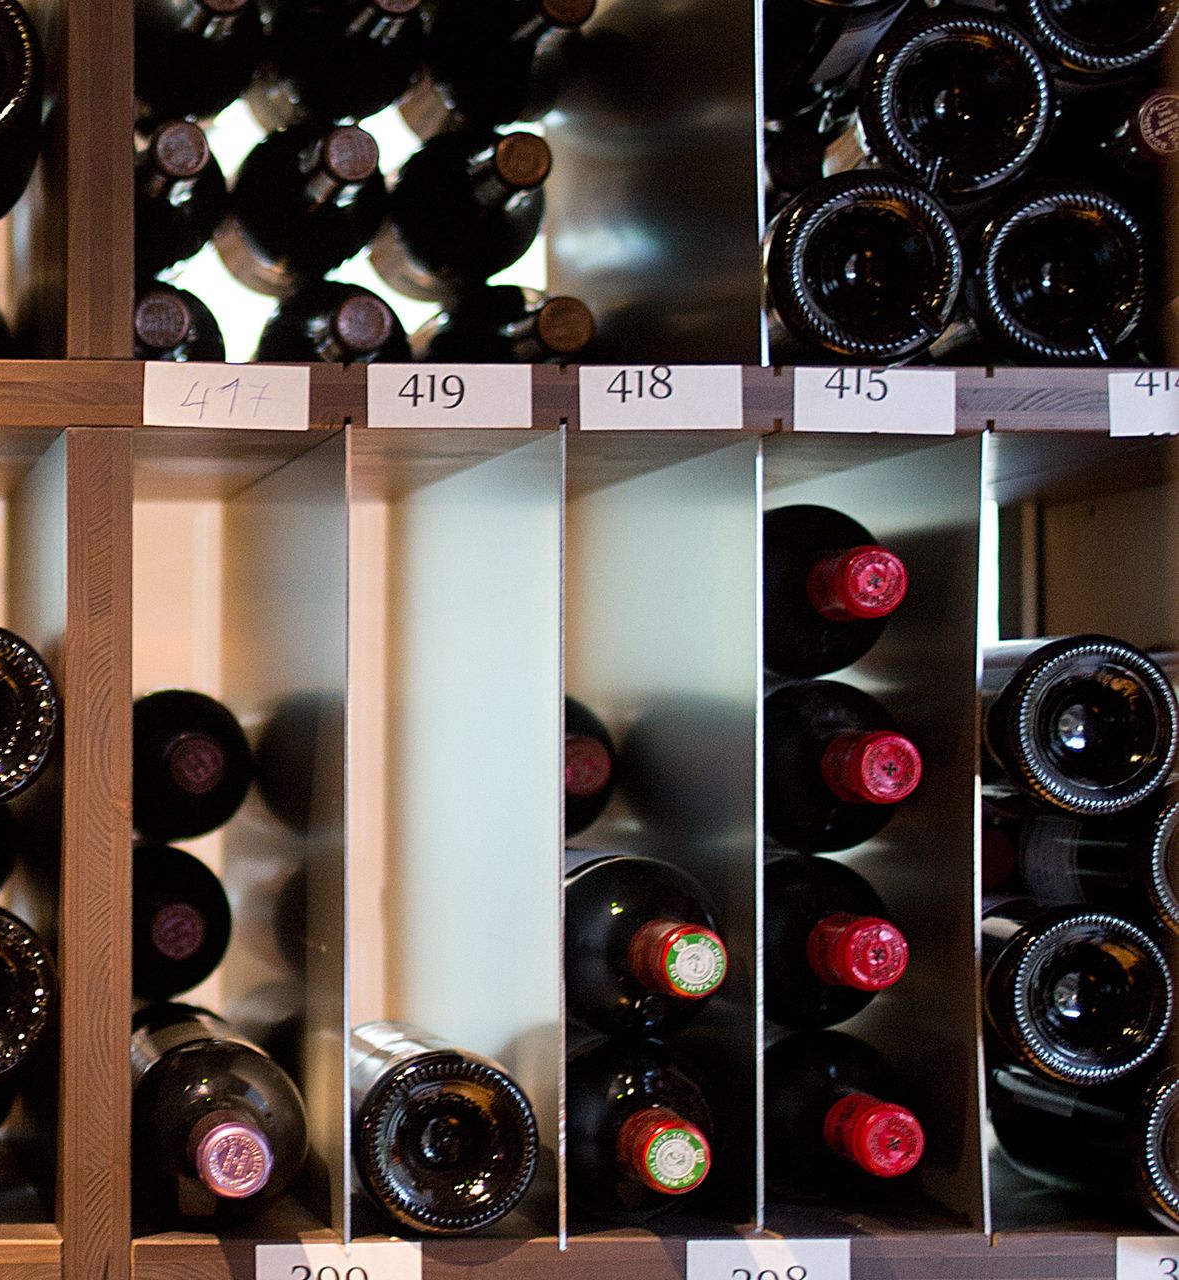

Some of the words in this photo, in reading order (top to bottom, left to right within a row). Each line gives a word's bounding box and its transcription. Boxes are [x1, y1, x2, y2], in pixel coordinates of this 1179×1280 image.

[397, 372, 467, 411] 419
[605, 366, 674, 404] 418
[823, 368, 889, 402] 415
[1134, 371, 1179, 397] 41
